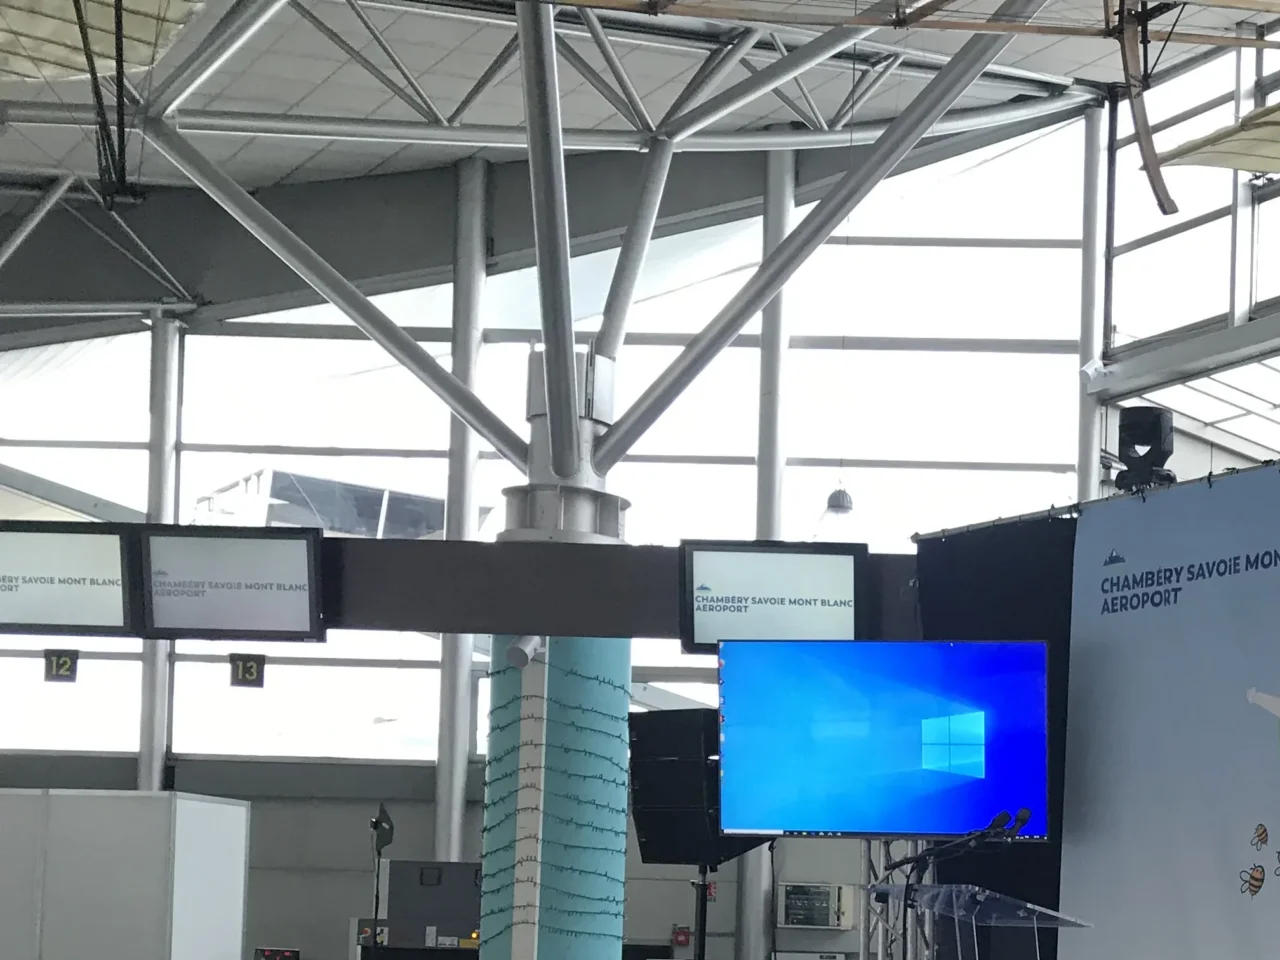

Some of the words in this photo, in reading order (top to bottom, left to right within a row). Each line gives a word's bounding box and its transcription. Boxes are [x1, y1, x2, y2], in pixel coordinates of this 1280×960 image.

[58, 576, 87, 586] MONT
[90, 578, 121, 587] BLANC
[1101, 565, 1185, 594] CHAMBÉRY
[245, 582, 274, 592] MONT
[276, 583, 308, 593] BLANC
[695, 603, 750, 613] AEROPORT
[788, 597, 818, 607] MONT
[821, 598, 853, 608] BLANC
[1100, 587, 1183, 615] AEROPORT
[50, 657, 71, 676] 12
[236, 661, 258, 681] 13
